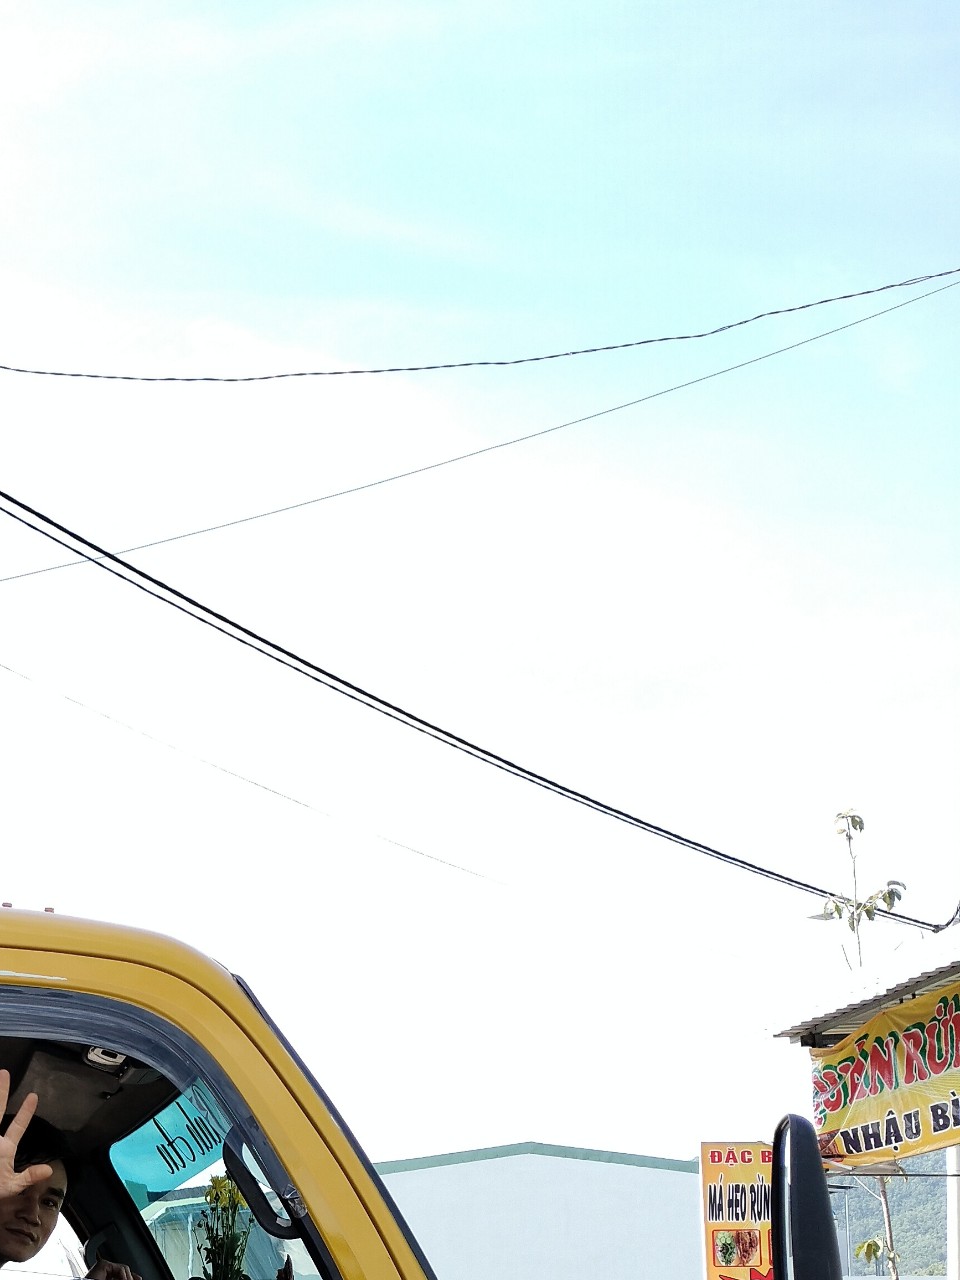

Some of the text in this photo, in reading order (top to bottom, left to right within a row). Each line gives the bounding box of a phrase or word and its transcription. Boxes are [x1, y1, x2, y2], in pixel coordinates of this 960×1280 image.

[840, 1090, 960, 1155] NHẬU BÌ
[709, 1147, 753, 1166] ĐẶC
[708, 1174, 771, 1224] MÁ HEO RỪN
